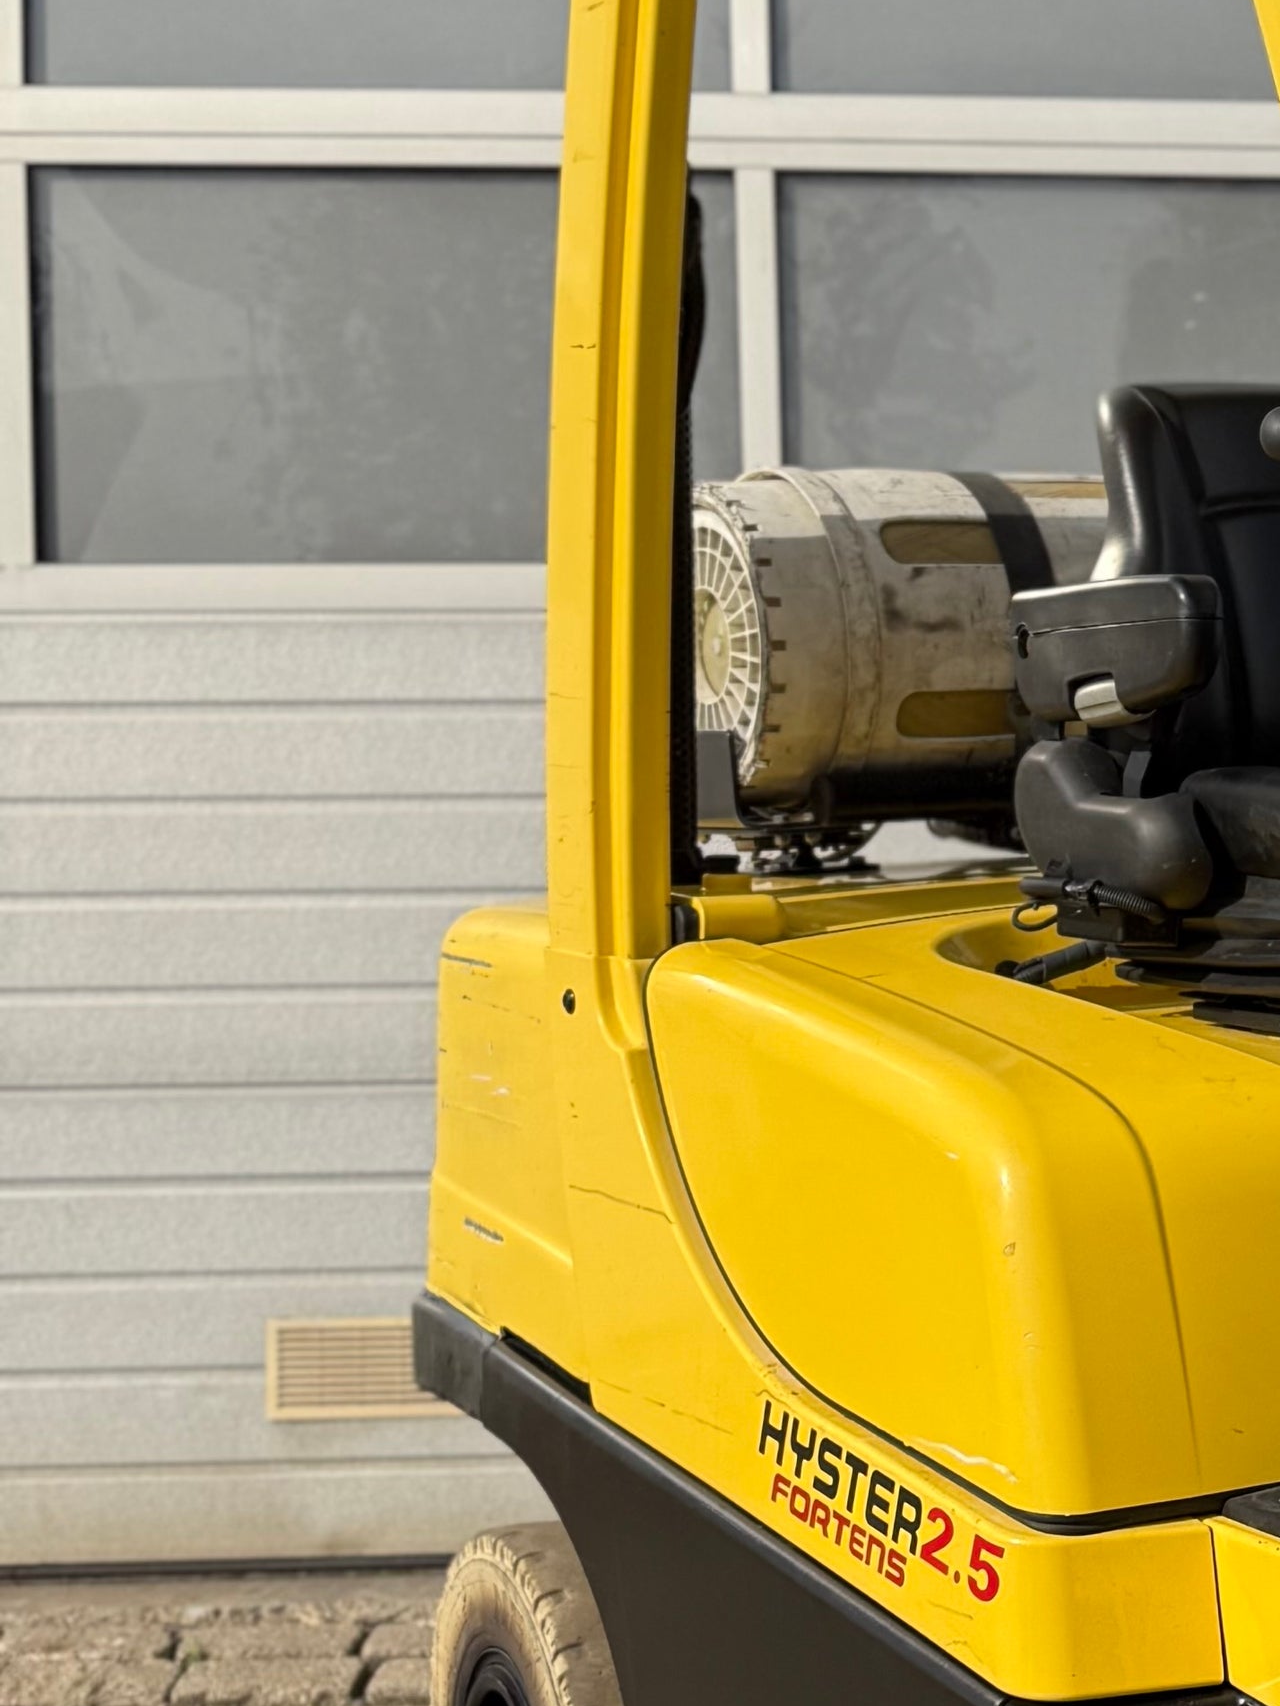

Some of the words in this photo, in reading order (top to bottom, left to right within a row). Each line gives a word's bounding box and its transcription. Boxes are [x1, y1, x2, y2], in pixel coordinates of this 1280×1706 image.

[758, 1400, 923, 1556] HYSTER
[919, 1507, 1006, 1602] 2.5
[771, 1473, 908, 1588] FORTENS
